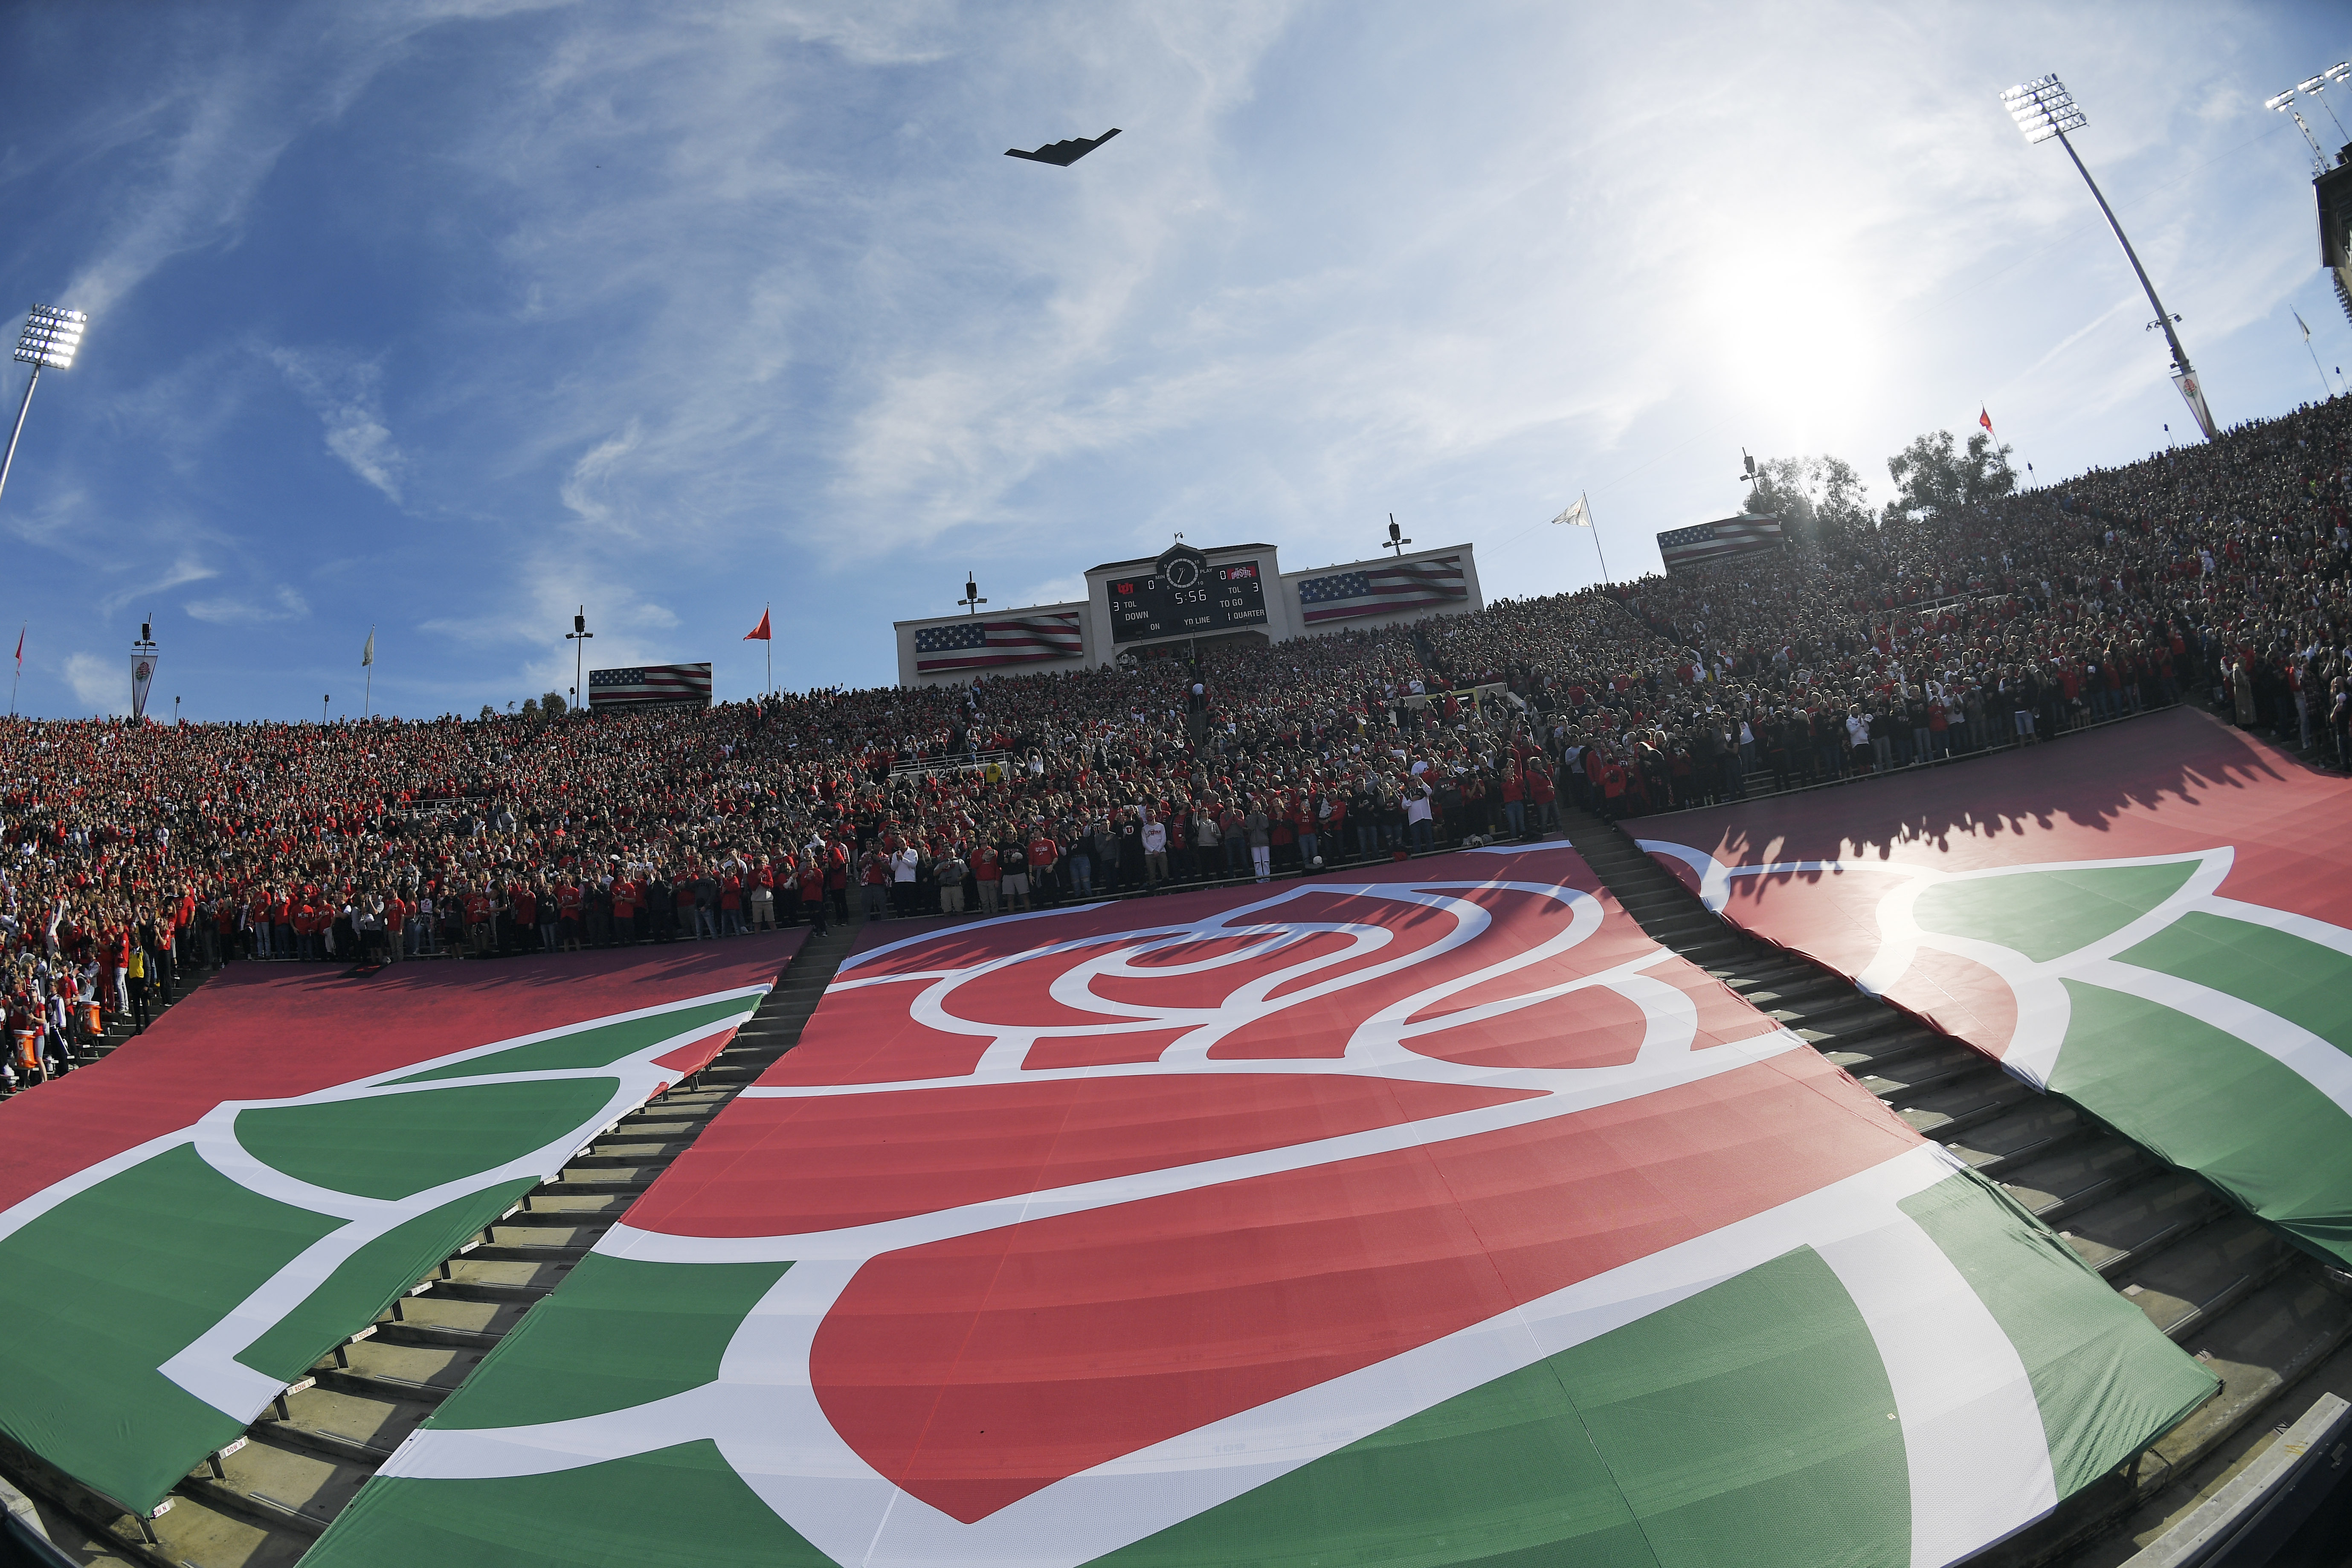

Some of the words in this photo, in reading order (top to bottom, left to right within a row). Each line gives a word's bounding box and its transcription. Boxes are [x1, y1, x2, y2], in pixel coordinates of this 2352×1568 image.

[1698, 558, 1723, 567] NCIDENTS
[1745, 546, 1777, 557] MISCONDUCT
[1220, 570, 1226, 580] 0
[1148, 580, 1154, 590] 0
[1252, 582, 1259, 592] 3
[1175, 589, 1206, 604] 5:56
[1113, 602, 1119, 612] 3
[1219, 600, 1230, 608] TO
[1232, 598, 1243, 606] GO
[1125, 611, 1149, 621] DOWN
[1234, 609, 1265, 619] QUARTER
[359, 1329, 369, 1339] ROW
[295, 1383, 305, 1392] ROW
[227, 1443, 238, 1454] ROW
[153, 1508, 162, 1516] OW
